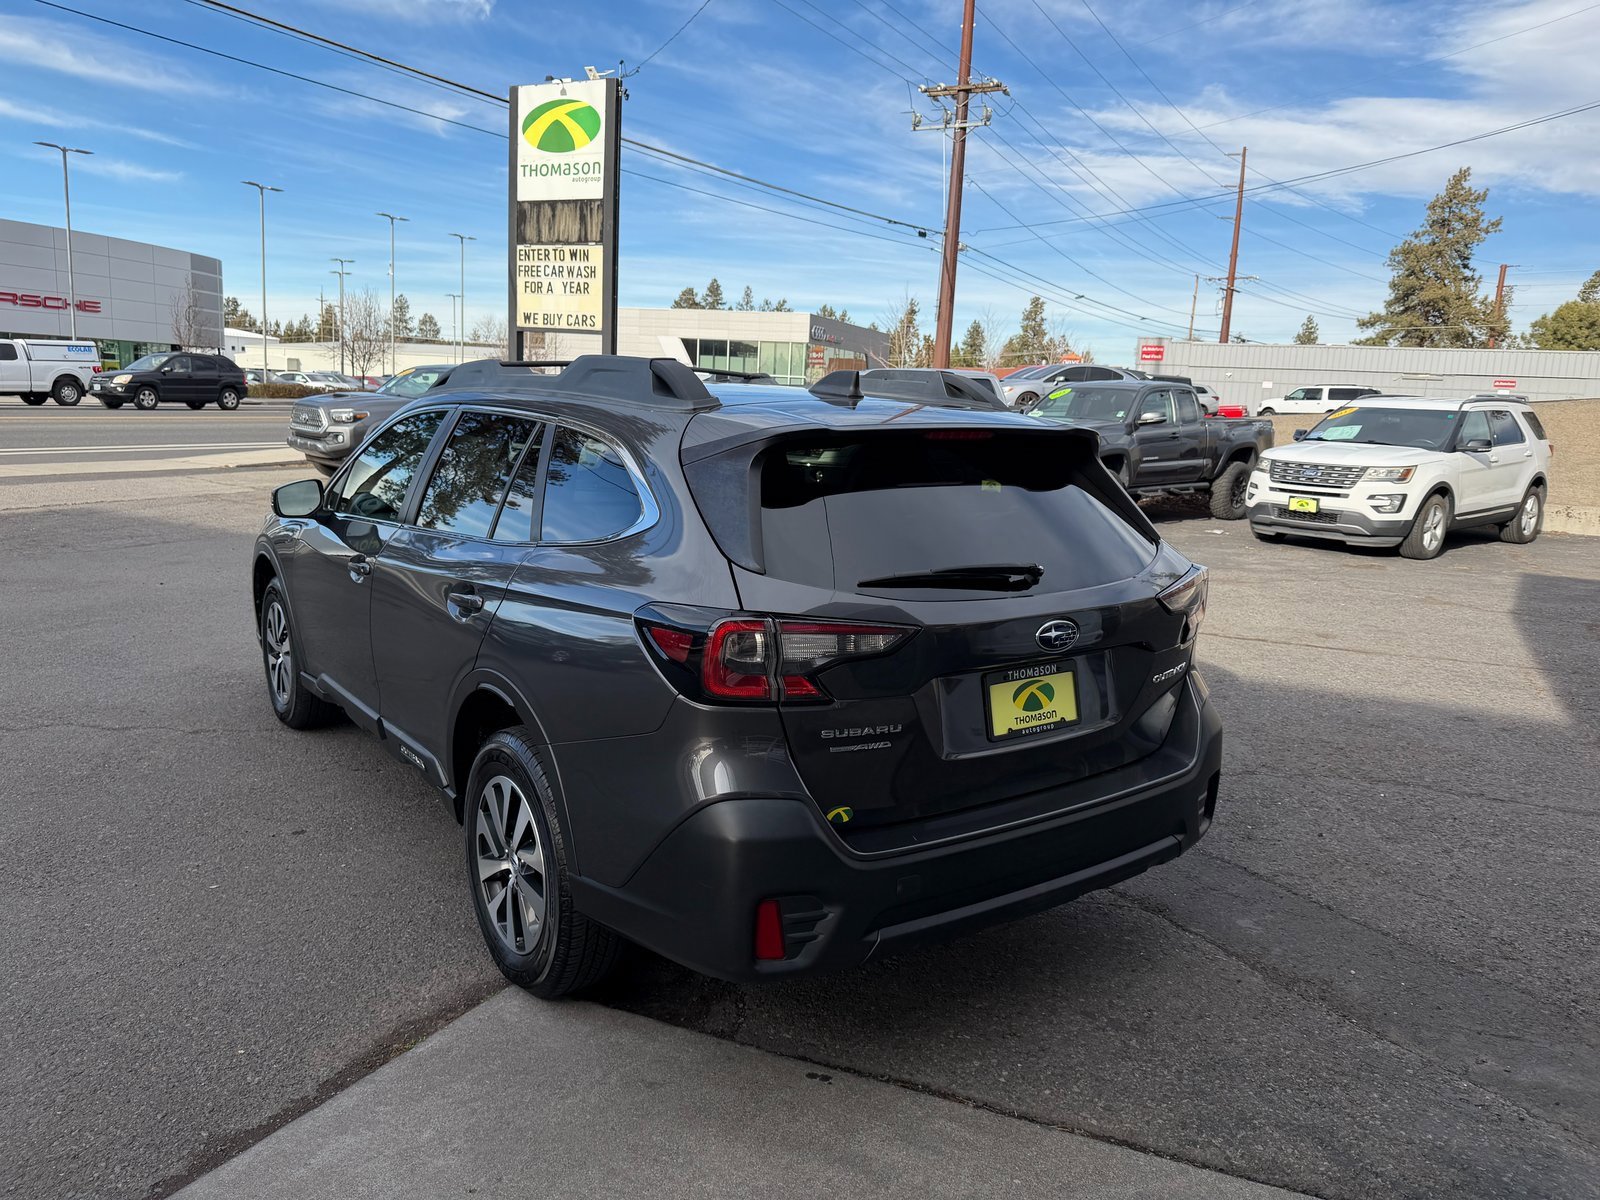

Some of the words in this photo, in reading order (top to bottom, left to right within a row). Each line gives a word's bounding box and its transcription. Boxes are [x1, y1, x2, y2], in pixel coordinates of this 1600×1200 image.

[518, 248, 550, 261] ENTER
[552, 248, 565, 262] TO
[569, 248, 590, 262] WIN
[518, 264, 542, 277] FREE
[543, 264, 565, 278] CAR
[566, 265, 597, 279] WASH
[524, 281, 543, 294] FOR
[546, 281, 554, 294] A
[562, 281, 590, 295] YEAR
[523, 312, 539, 325] WE
[542, 313, 563, 326] BUY
[566, 314, 596, 328] CARS
[67, 345, 93, 353] ECOLAB
[821, 724, 902, 739] SUBARU
[1022, 723, 1055, 734] autogroup
[854, 741, 892, 751] AWD
